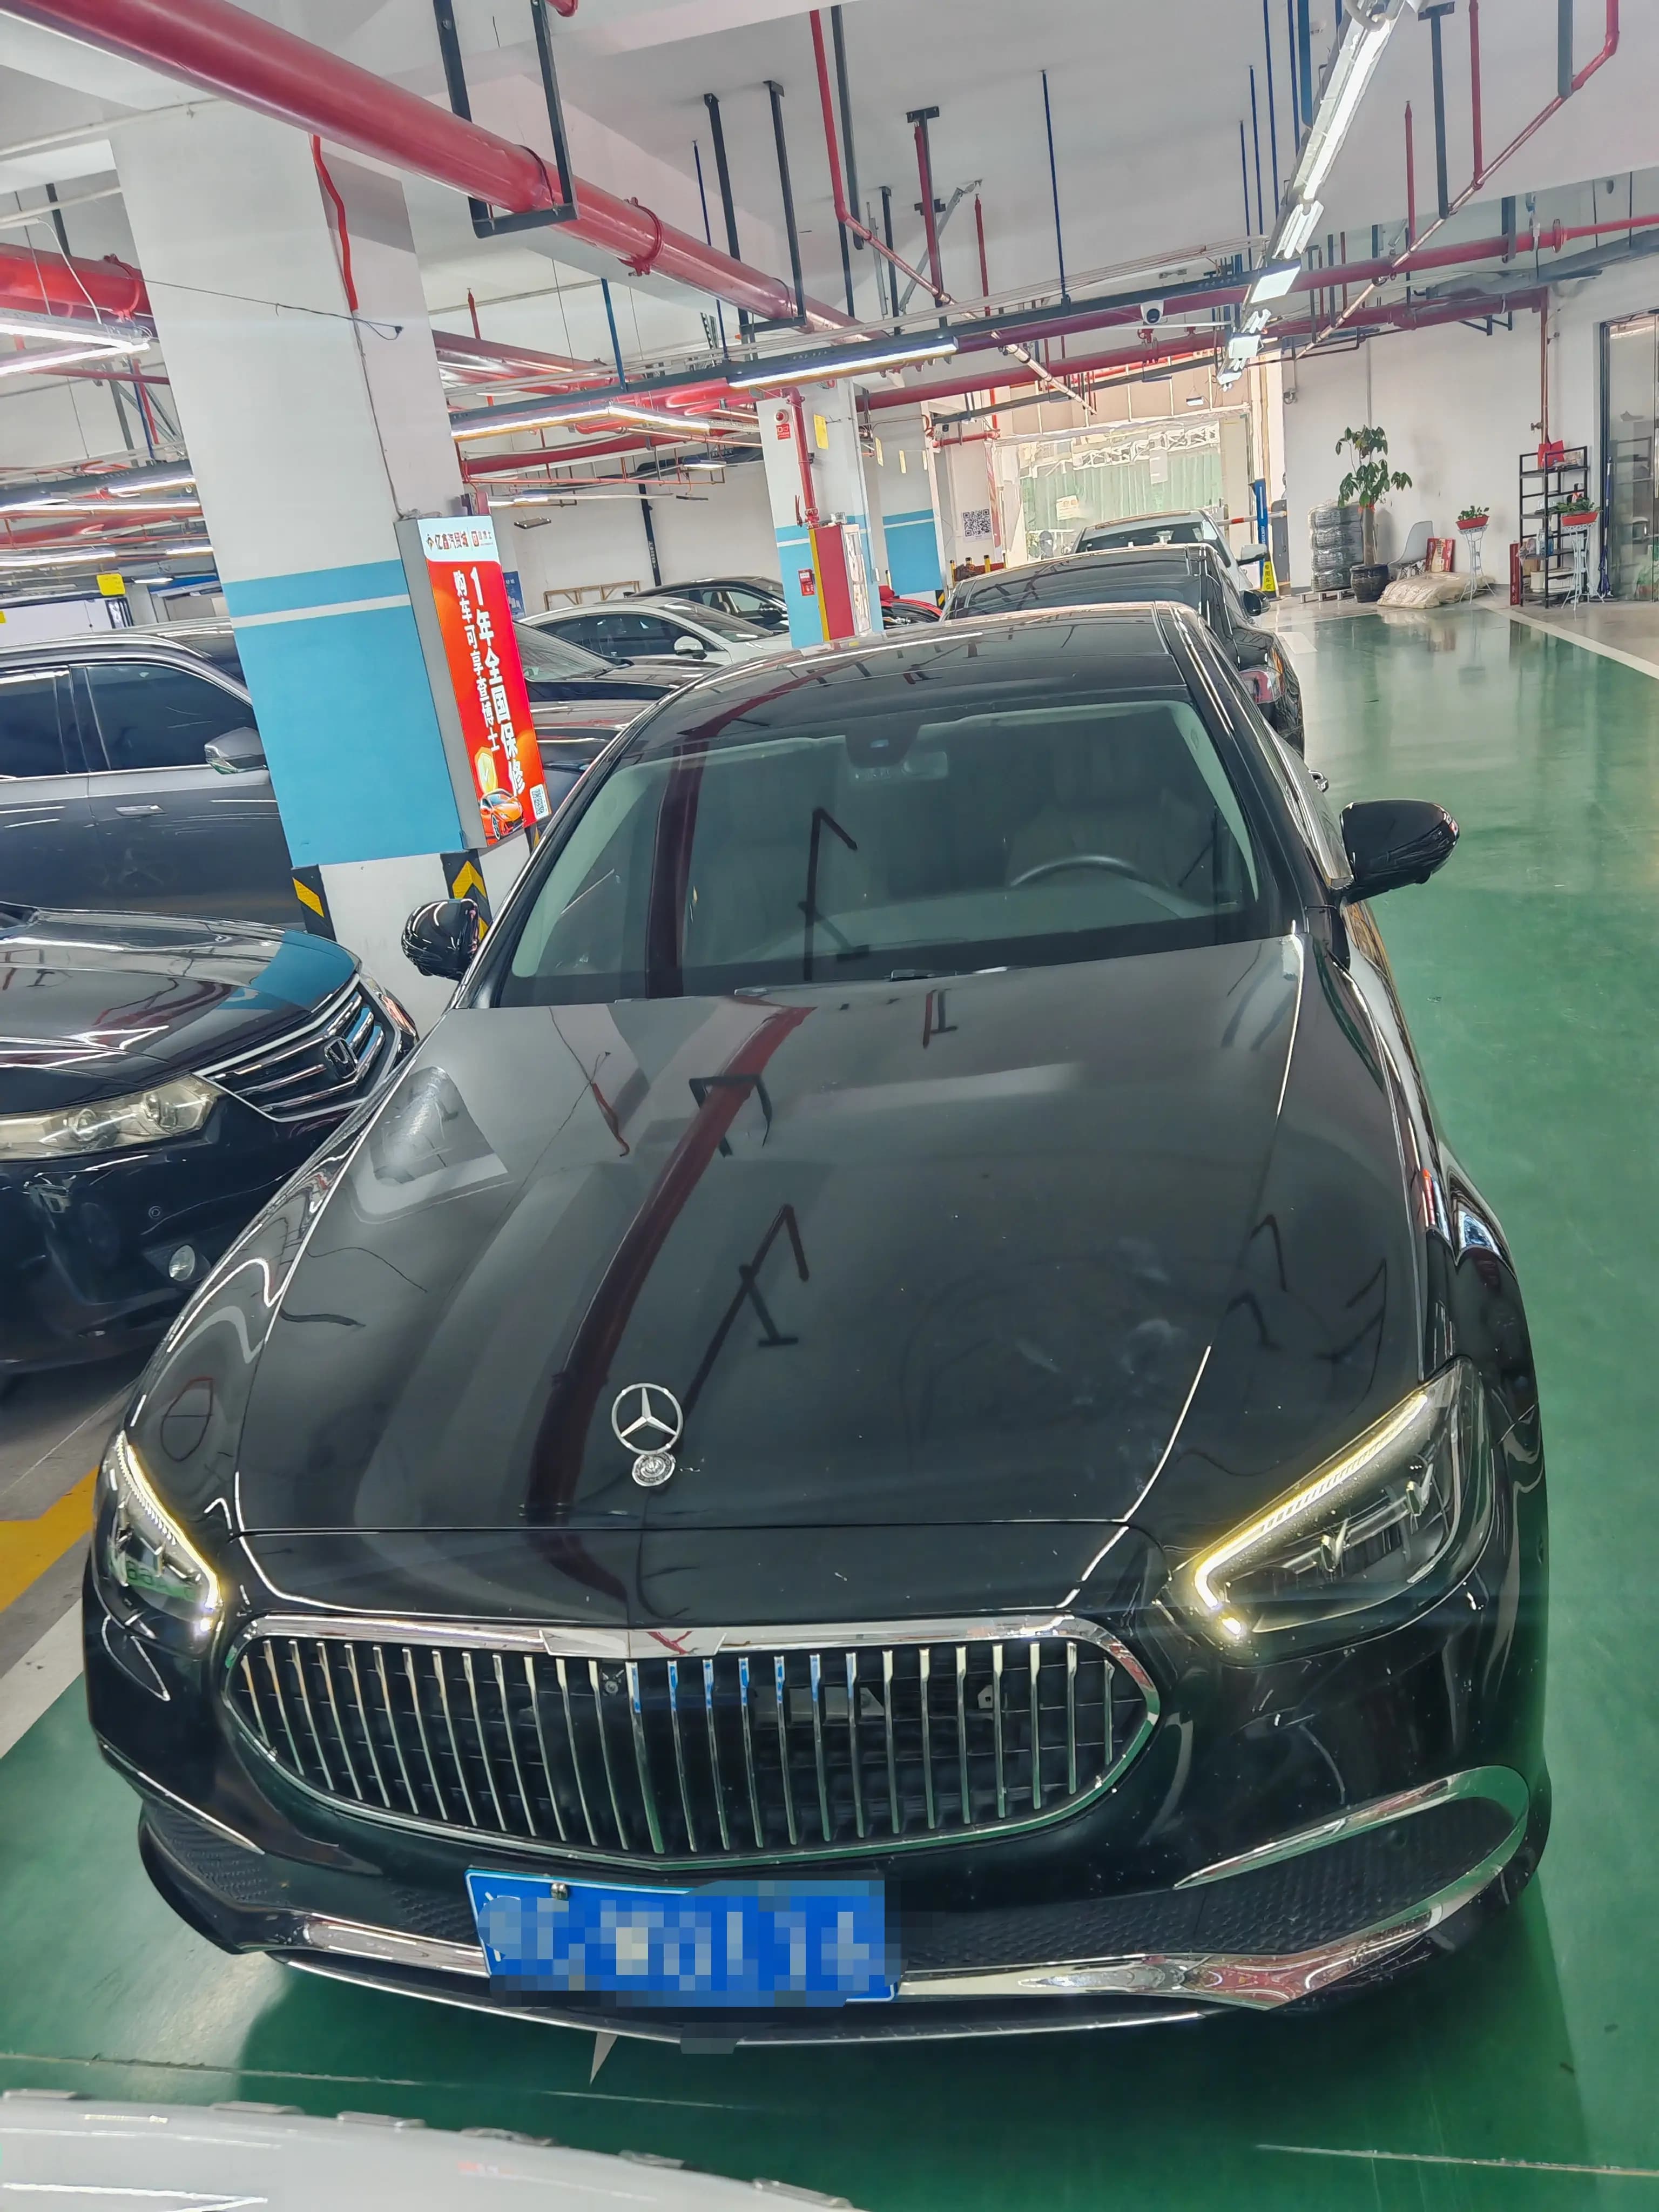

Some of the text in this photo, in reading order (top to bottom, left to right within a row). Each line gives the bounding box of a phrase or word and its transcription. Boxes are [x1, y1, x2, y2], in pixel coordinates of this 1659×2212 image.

[453, 570, 500, 752] 购车可享查博士
[470, 567, 525, 797] 1年全国保修
